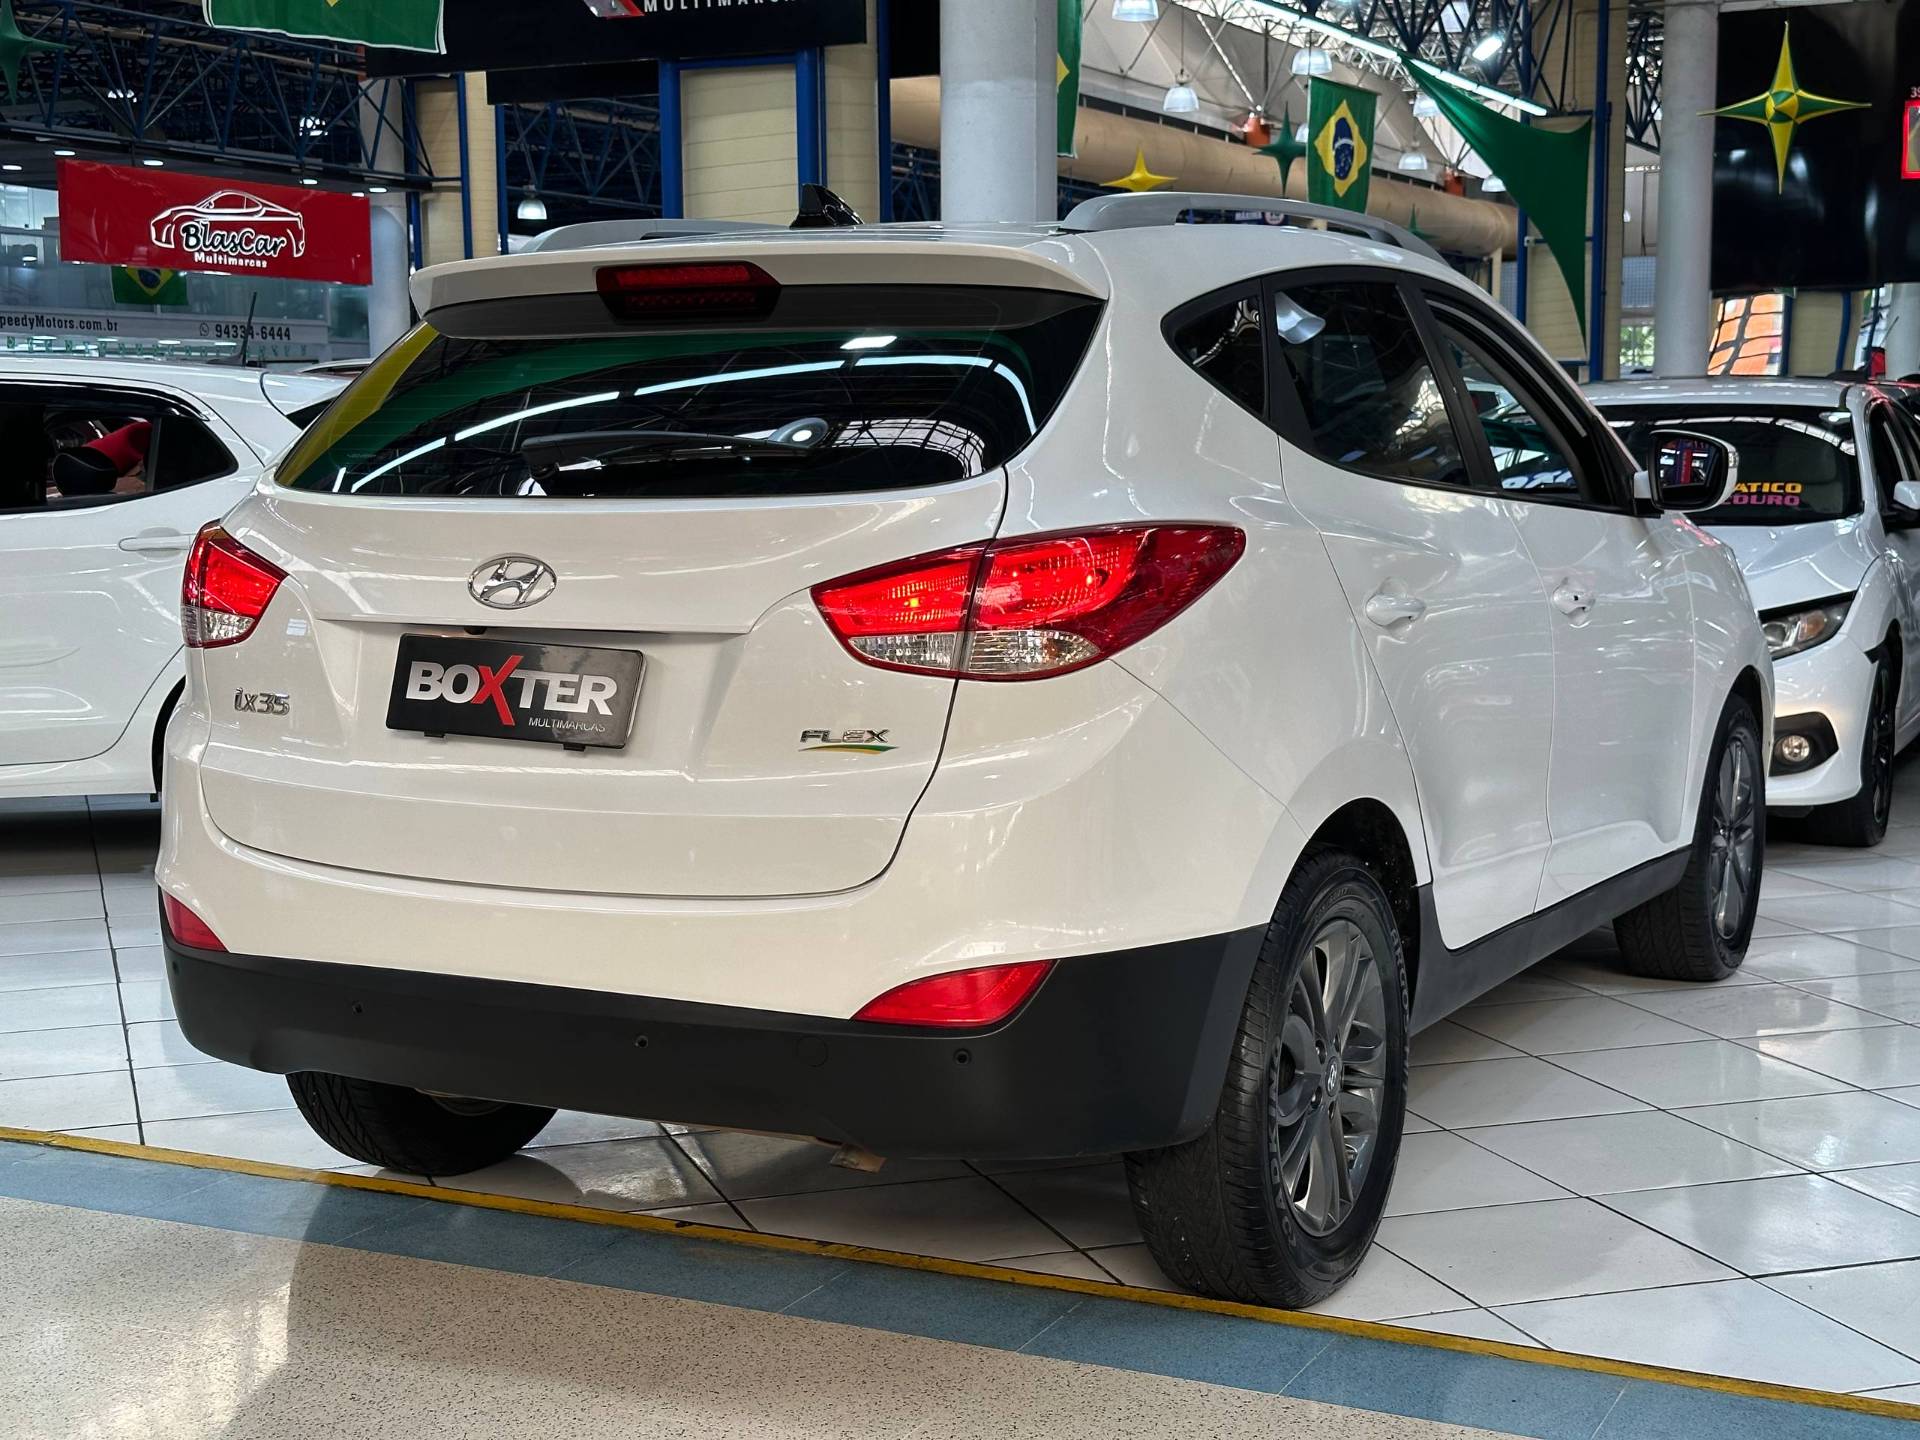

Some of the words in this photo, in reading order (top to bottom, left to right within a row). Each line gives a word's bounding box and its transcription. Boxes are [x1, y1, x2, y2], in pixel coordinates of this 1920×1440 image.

[181, 221, 287, 257] BlasCar
[194, 251, 268, 268] Multimarcas
[234, 687, 290, 715] ix35
[406, 655, 617, 726] BOXTER
[528, 717, 606, 732] MULTIMARCAS
[800, 729, 890, 743] FLEX
